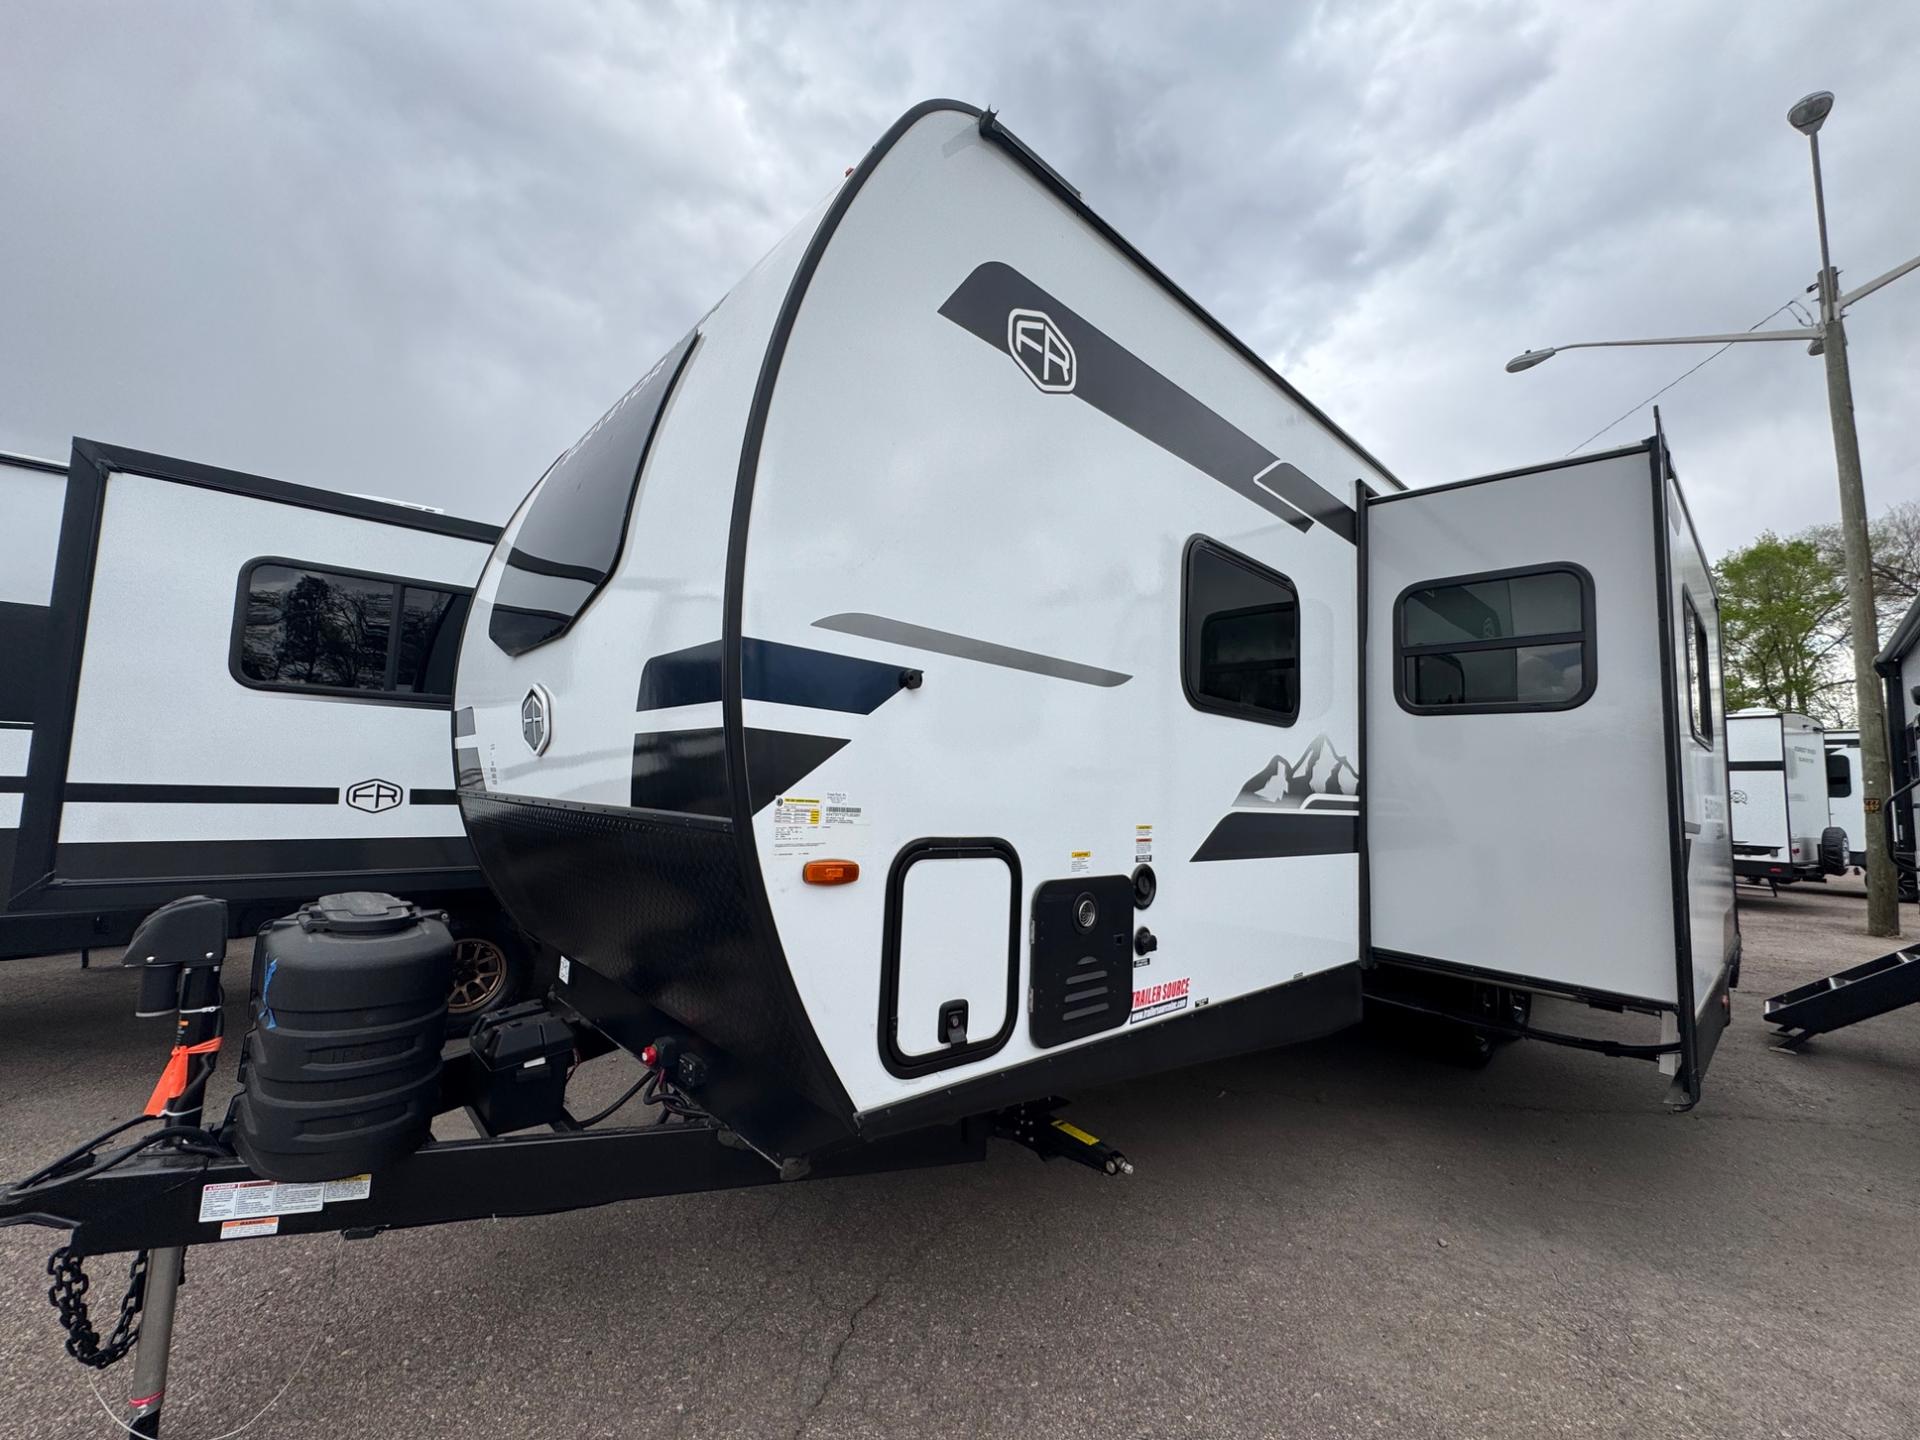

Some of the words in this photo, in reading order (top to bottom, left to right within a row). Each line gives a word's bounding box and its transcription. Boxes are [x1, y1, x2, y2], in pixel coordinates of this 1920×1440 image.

[1015, 320, 1070, 382] FR
[352, 783, 398, 809] FR
[1133, 987, 1161, 1008] TRAILER
[1162, 977, 1190, 1000] SOURCE
